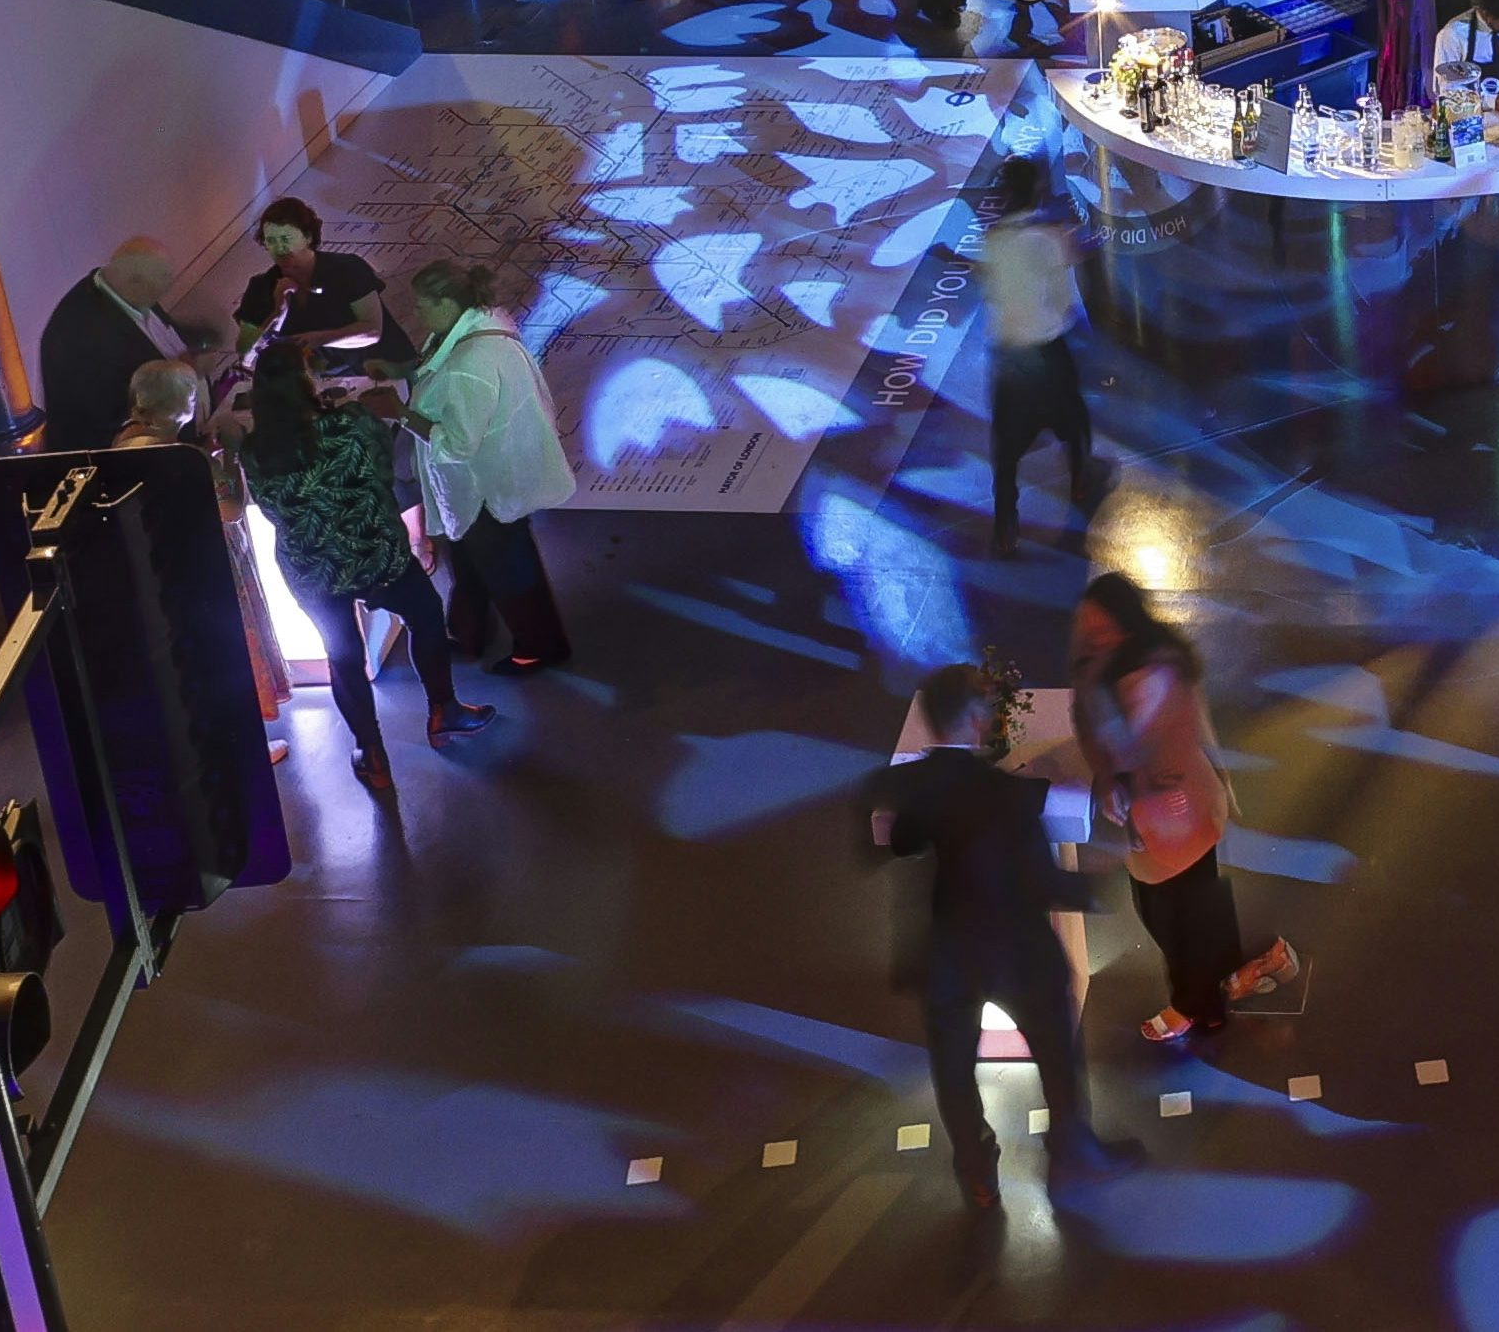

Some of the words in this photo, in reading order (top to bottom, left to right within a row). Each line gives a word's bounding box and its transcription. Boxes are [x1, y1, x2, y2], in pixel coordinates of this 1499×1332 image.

[872, 353, 930, 407] HOW
[905, 308, 949, 355] DID
[927, 263, 974, 309] YOU
[719, 465, 740, 494] MAYOR
[738, 432, 762, 466] LONDON
